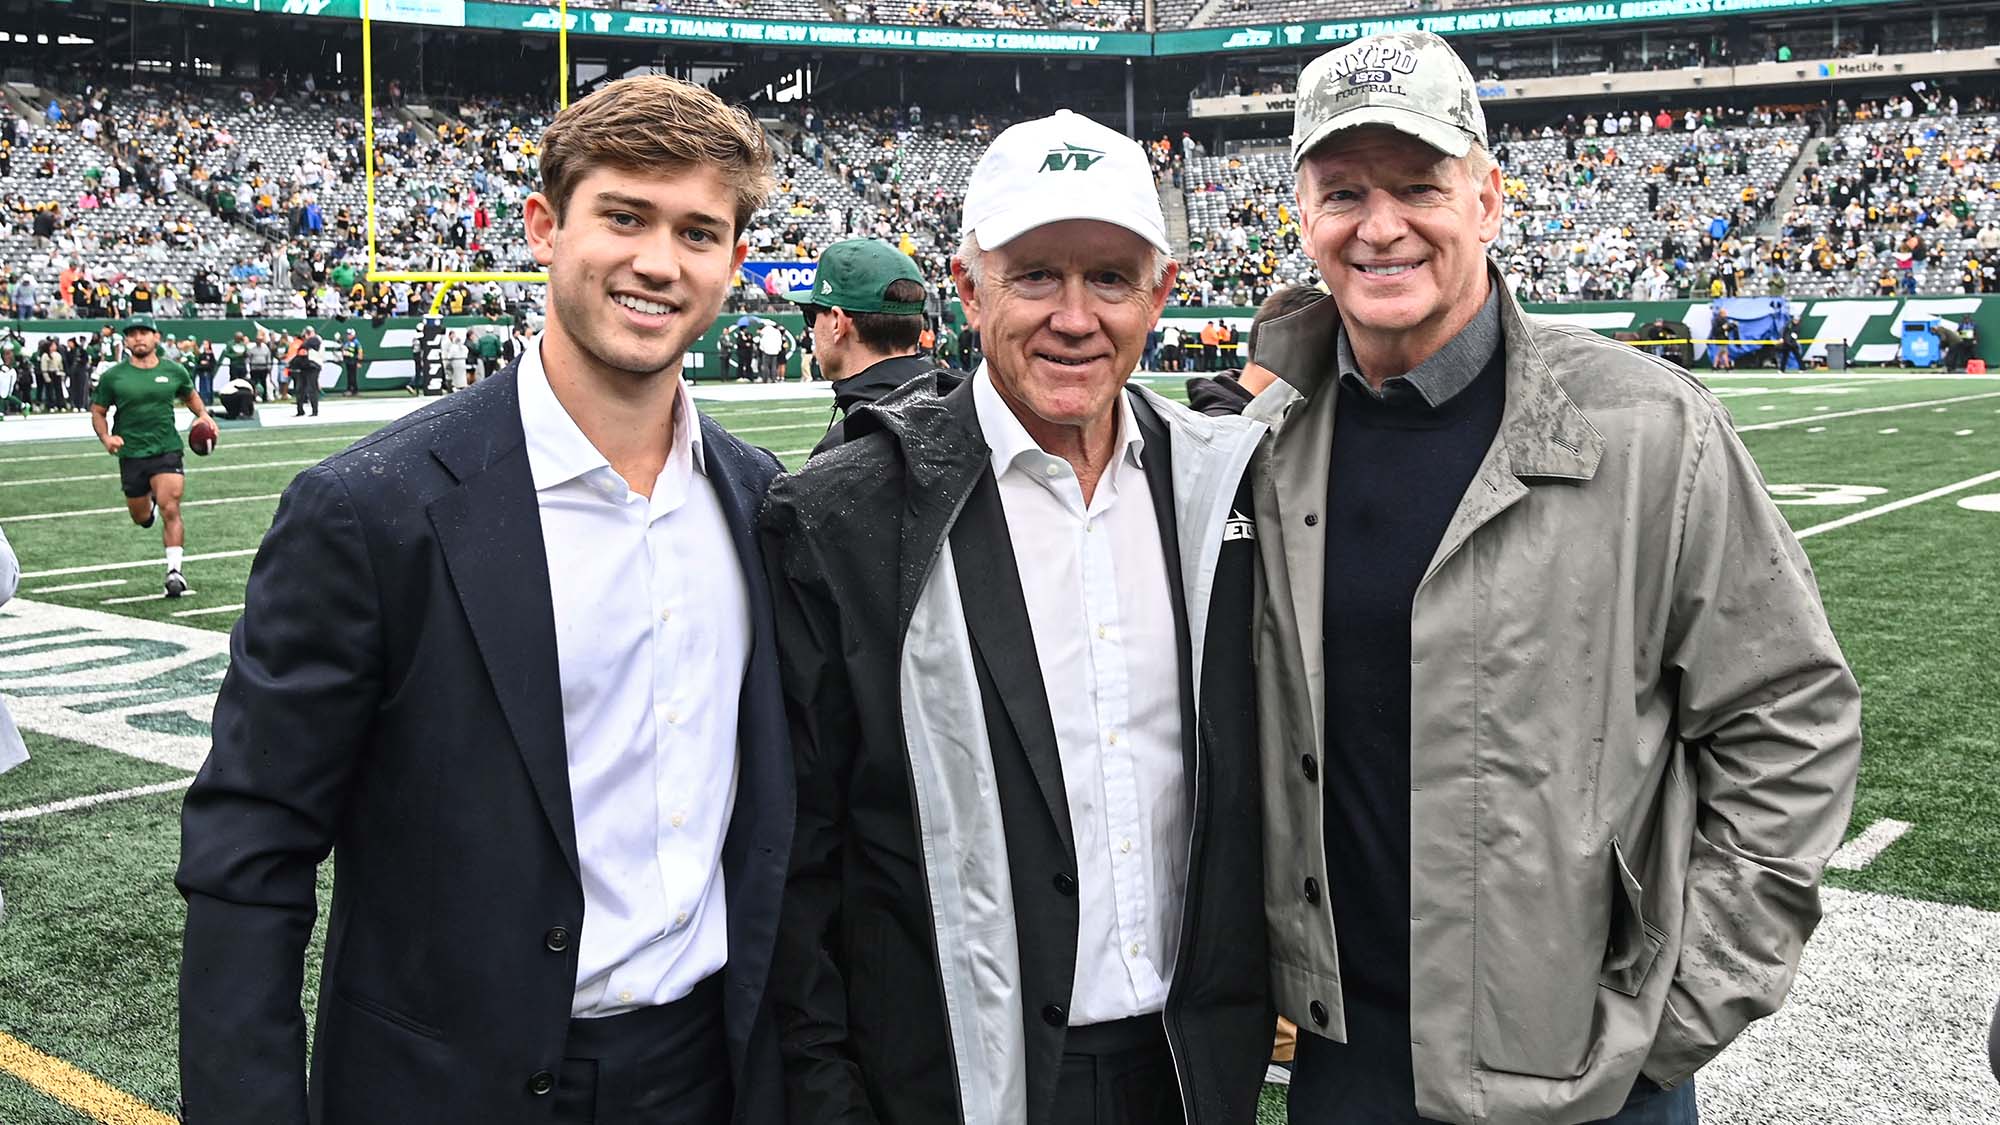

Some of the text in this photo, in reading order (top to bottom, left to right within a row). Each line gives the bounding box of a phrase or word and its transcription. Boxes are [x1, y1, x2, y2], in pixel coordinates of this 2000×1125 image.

[1315, 23, 1359, 41] JETS
[1421, 16, 1457, 33] THE
[1456, 12, 1502, 30] NEW
[1501, 9, 1553, 27] YORK
[1553, 4, 1618, 23] SMALL
[1619, 0, 1711, 18] BUSINESS
[624, 17, 1100, 51] JETS THANK THE NEW YORK SMALL BUSINESS COMMUNITY
[1329, 45, 1418, 83] NYPD
[1838, 62, 1884, 73] MetLife
[1355, 72, 1385, 83] 1973
[1336, 84, 1407, 102] FOOTBALL
[1038, 151, 1105, 173] NY
